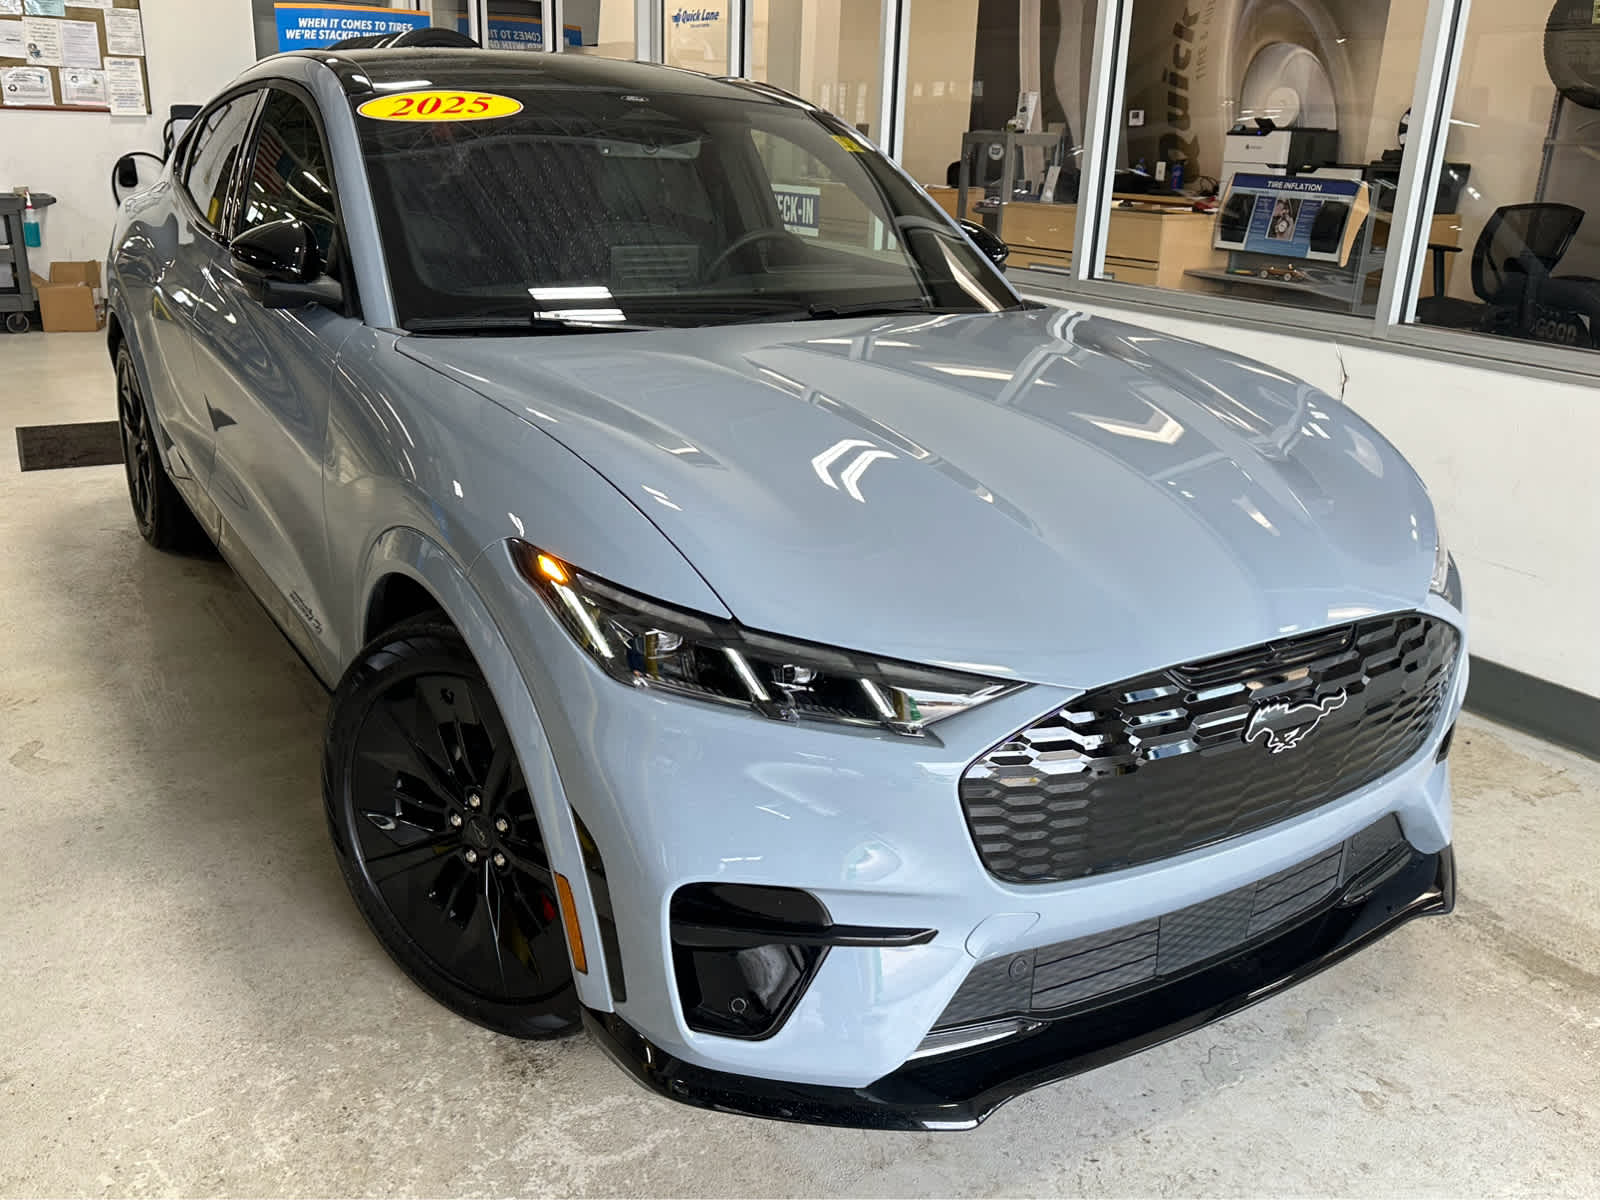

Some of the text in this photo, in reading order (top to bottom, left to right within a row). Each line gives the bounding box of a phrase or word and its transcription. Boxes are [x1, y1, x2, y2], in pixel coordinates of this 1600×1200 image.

[682, 9, 719, 24] Quick Lane
[298, 17, 413, 33] WHEN IT COMES TO TIRES
[286, 29, 316, 40] WE'RE
[389, 96, 493, 117] 2025
[1267, 181, 1323, 192] TIRE INFLATION
[774, 193, 814, 224] ECK-IN
